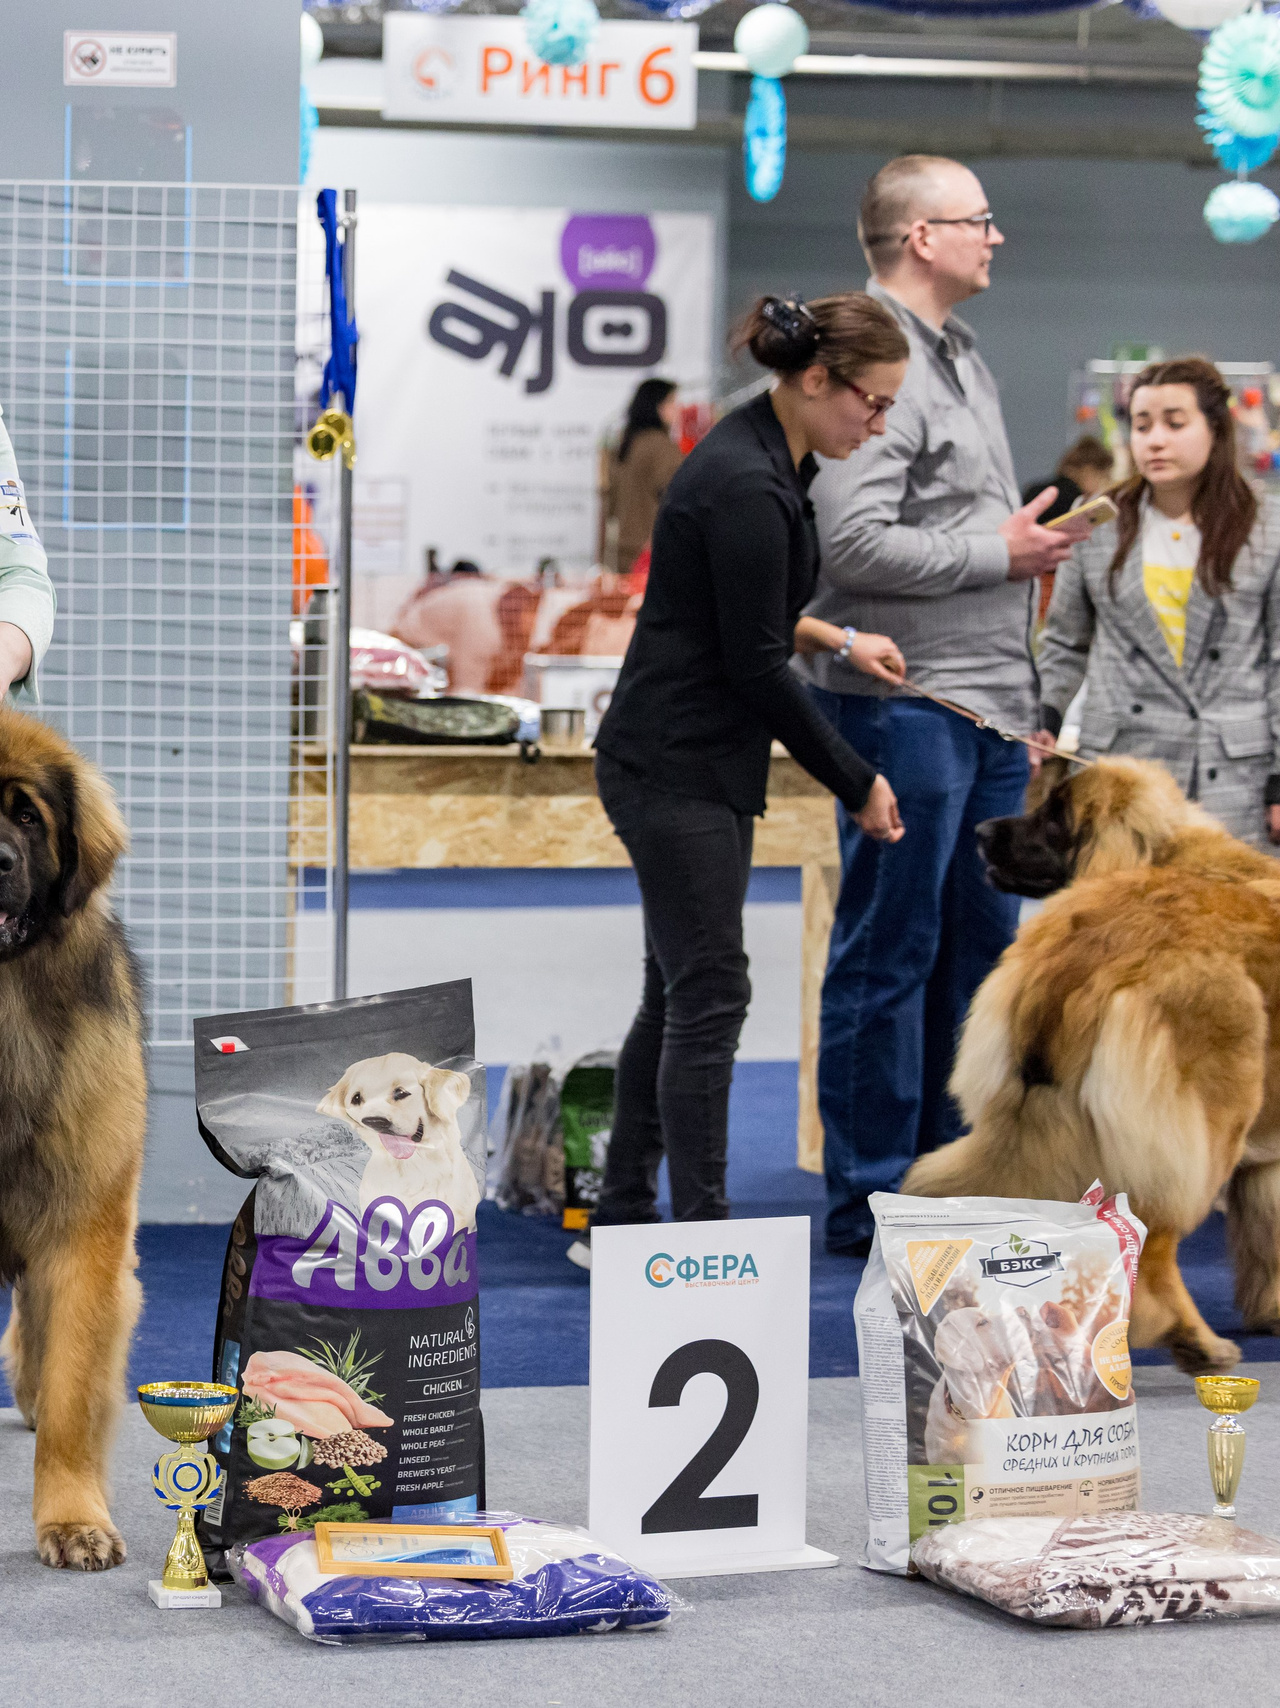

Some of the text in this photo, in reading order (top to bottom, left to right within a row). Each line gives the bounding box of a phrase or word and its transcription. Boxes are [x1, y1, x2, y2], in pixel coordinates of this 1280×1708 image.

[480, 46, 675, 106] Ринг 6
[645, 1252, 759, 1288] СФЕРА
[1000, 1259, 1042, 1271] БЭКС
[685, 1279, 736, 1288] ВЫСТАВОЧНЫЙ
[410, 1329, 465, 1349] NATURAL
[408, 1342, 476, 1368] INGREDIENTS
[423, 1379, 462, 1395] CHICKEN
[403, 1410, 455, 1422] FRESH CHICKEN
[402, 1424, 454, 1436] WHOLE BARLEY
[641, 1338, 760, 1535] 2
[401, 1439, 446, 1450] WHOLE PEAS
[1007, 1432, 1057, 1452] КОРМ
[1061, 1427, 1103, 1454] ДЛЯ
[399, 1456, 430, 1464] LINSEED
[1003, 1456, 1058, 1474] СРЕДНИХ
[1063, 1455, 1070, 1467] И
[1074, 1450, 1119, 1466] КРУПНЫХ
[397, 1464, 456, 1478] BREWER'S YEAST
[396, 1481, 445, 1492] FRESH APPLE
[1026, 1484, 1072, 1493] ПИЩЕВАРЕНИЕ
[411, 1507, 446, 1519] ADULT
